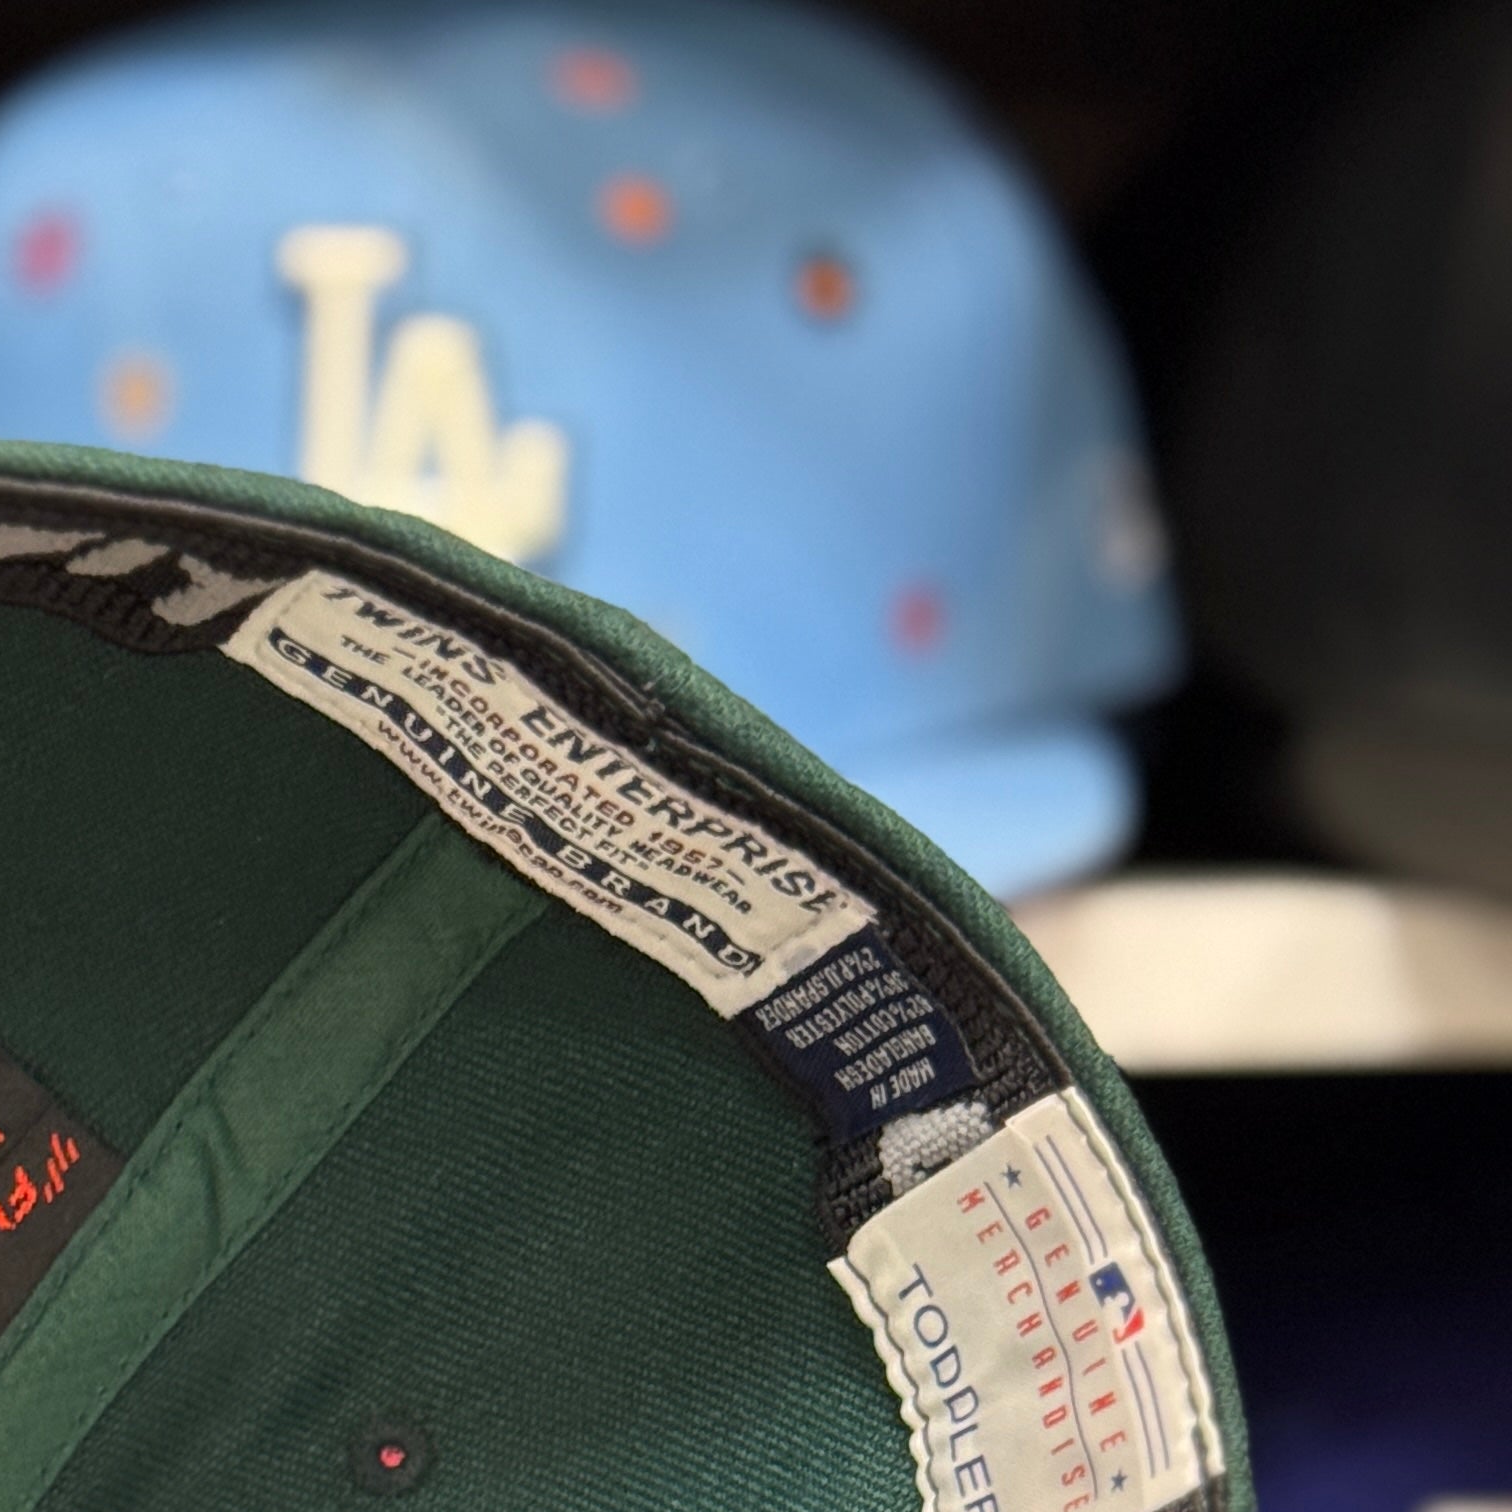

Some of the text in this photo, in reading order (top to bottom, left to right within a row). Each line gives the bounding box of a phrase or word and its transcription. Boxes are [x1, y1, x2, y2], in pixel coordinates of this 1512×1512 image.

[274, 224, 569, 568] LA
[276, 638, 753, 965] GENUINE BRAND
[321, 585, 842, 913] TWINS ENTERPRISE
[341, 636, 752, 916] THE LEADER OF QUALITY HEADWEAR
[418, 659, 724, 875] INCORPORATED 1957
[487, 761, 594, 840] PERFECT
[833, 1024, 937, 1092] BANGLADESH
[869, 1057, 936, 1110] MADE IN
[1024, 1207, 1127, 1454] GENUINE
